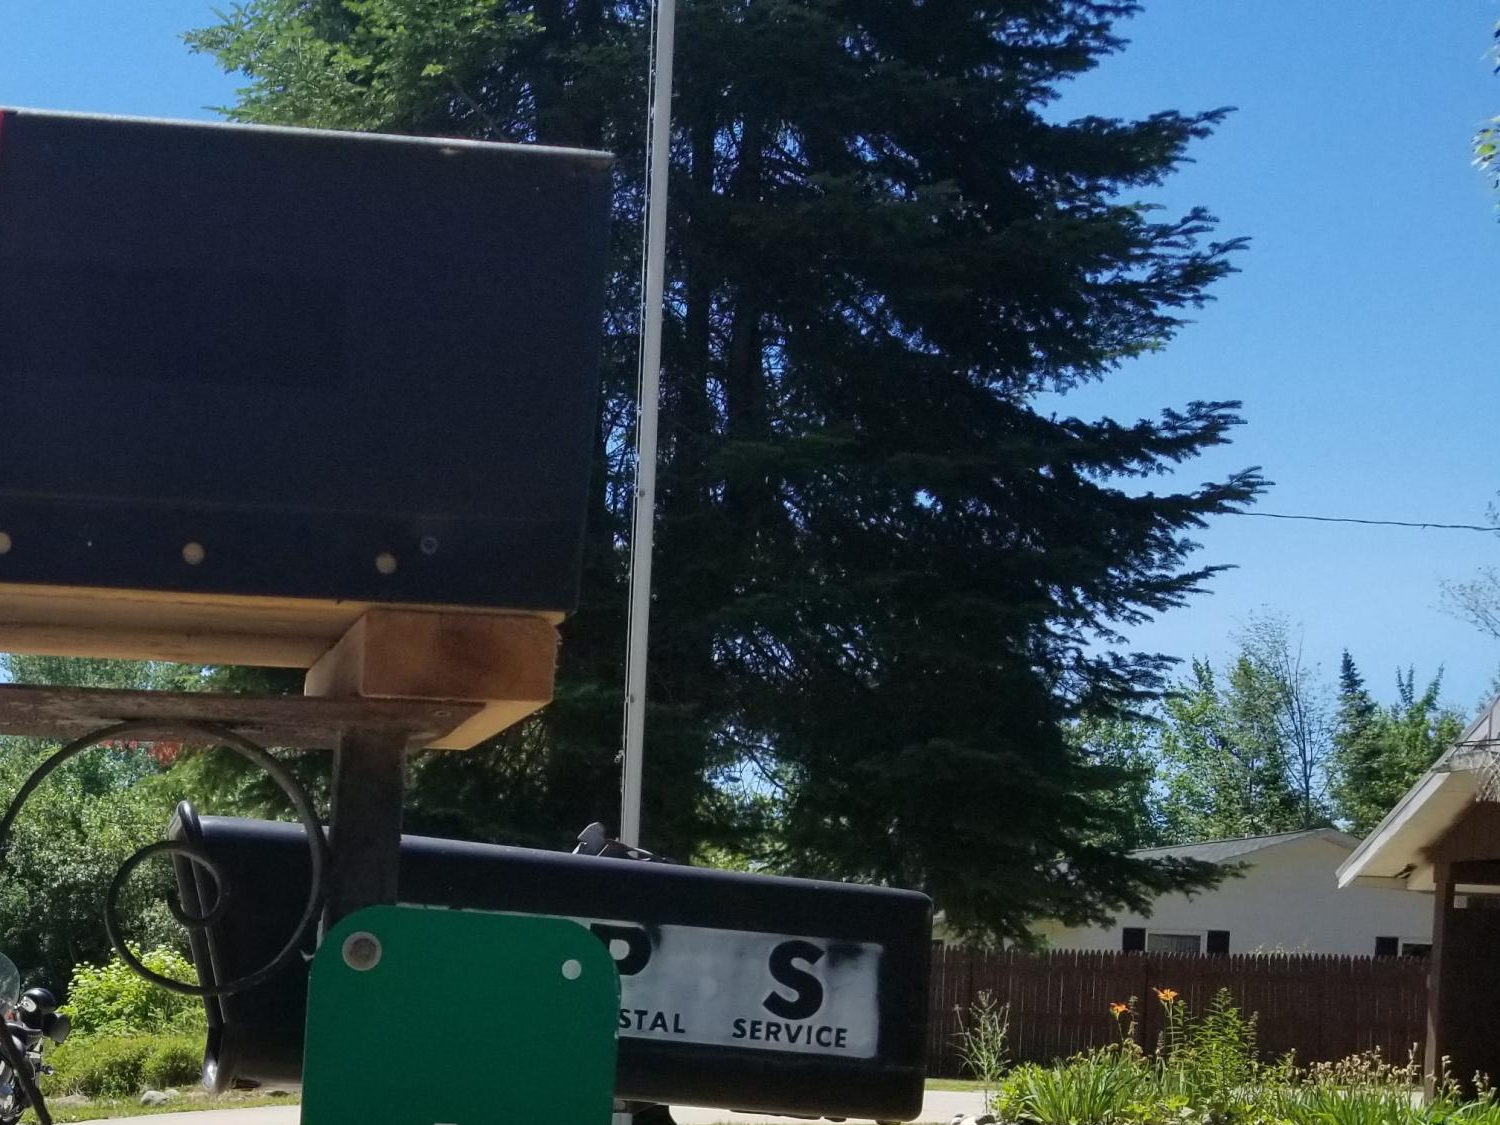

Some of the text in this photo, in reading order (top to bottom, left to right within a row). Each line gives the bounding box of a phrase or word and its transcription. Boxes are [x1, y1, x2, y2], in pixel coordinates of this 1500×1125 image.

[762, 940, 825, 1020] S
[618, 1008, 848, 1049] STAL SERVICE
